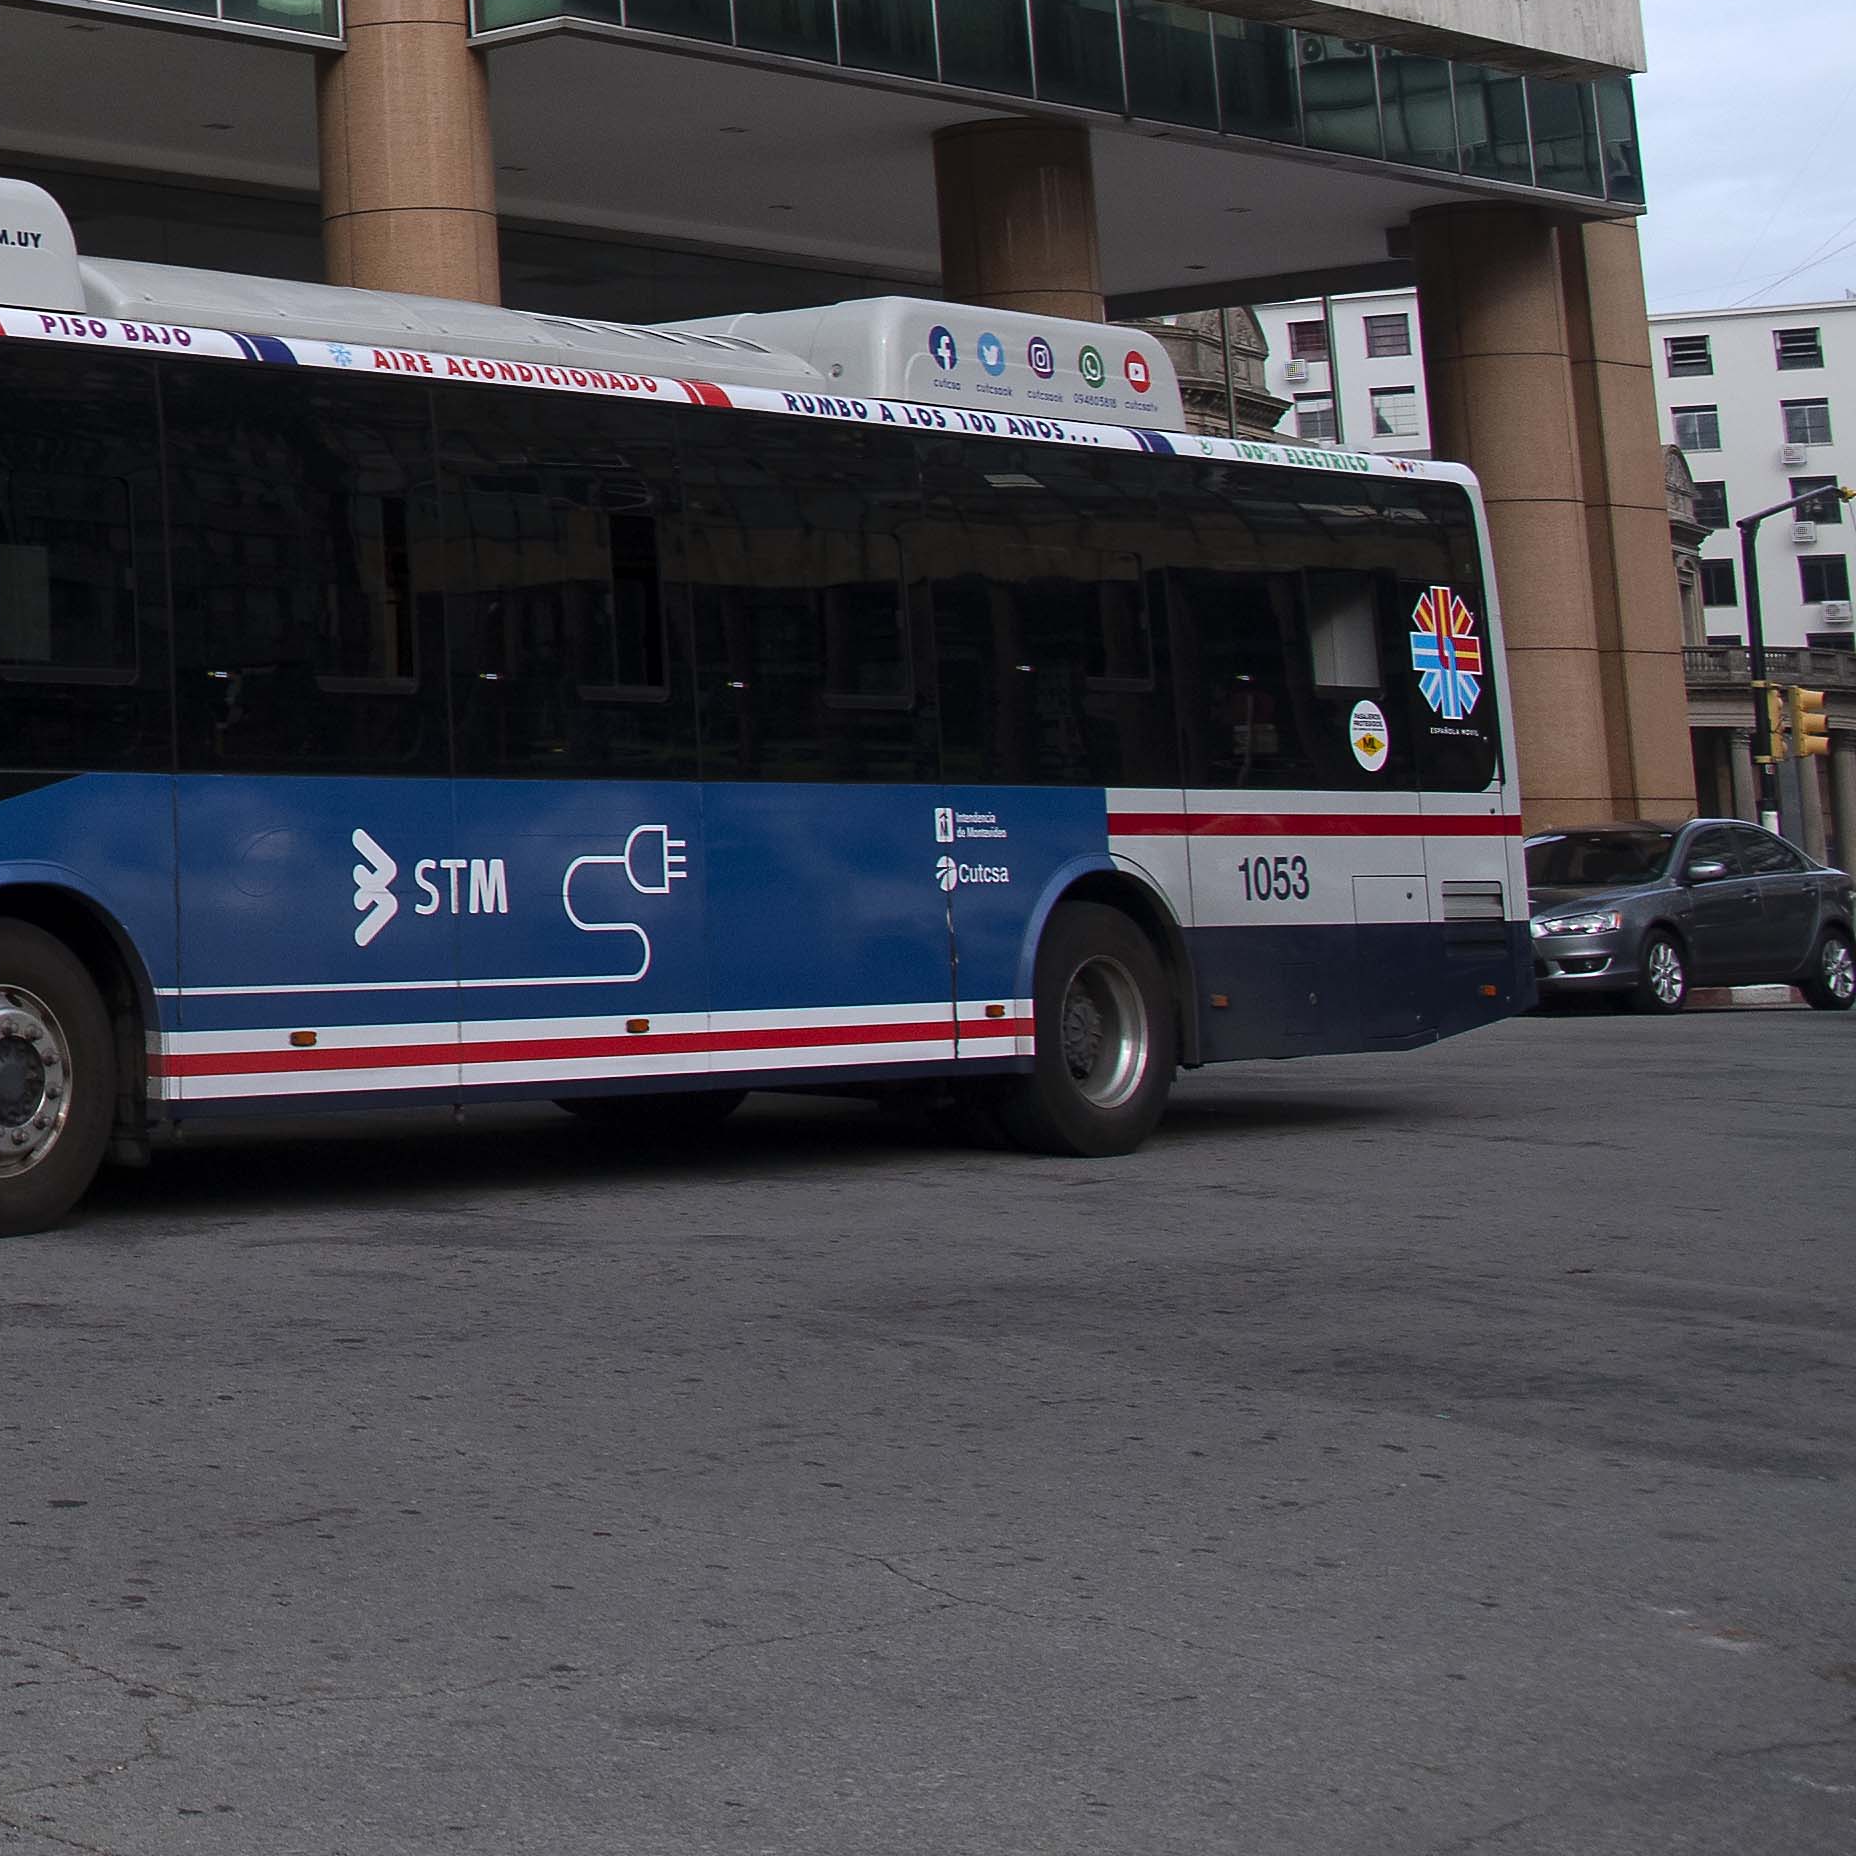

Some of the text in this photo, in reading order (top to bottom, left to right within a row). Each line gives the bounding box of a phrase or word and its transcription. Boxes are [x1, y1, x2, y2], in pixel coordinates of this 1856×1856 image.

[39, 314, 191, 347] PISO BAJO
[373, 349, 658, 394] AIRE ACONDICIONADO
[781, 392, 868, 420] RUMBO
[878, 402, 896, 424] A
[901, 405, 947, 429] LOS
[954, 411, 996, 434] 100
[1230, 441, 1279, 462] 100%
[955, 811, 996, 823] Intendencia
[956, 826, 1008, 838] de Montevideo
[414, 858, 508, 915] STM
[958, 863, 1010, 883] Cutcsa
[1238, 855, 1310, 901] 1053
